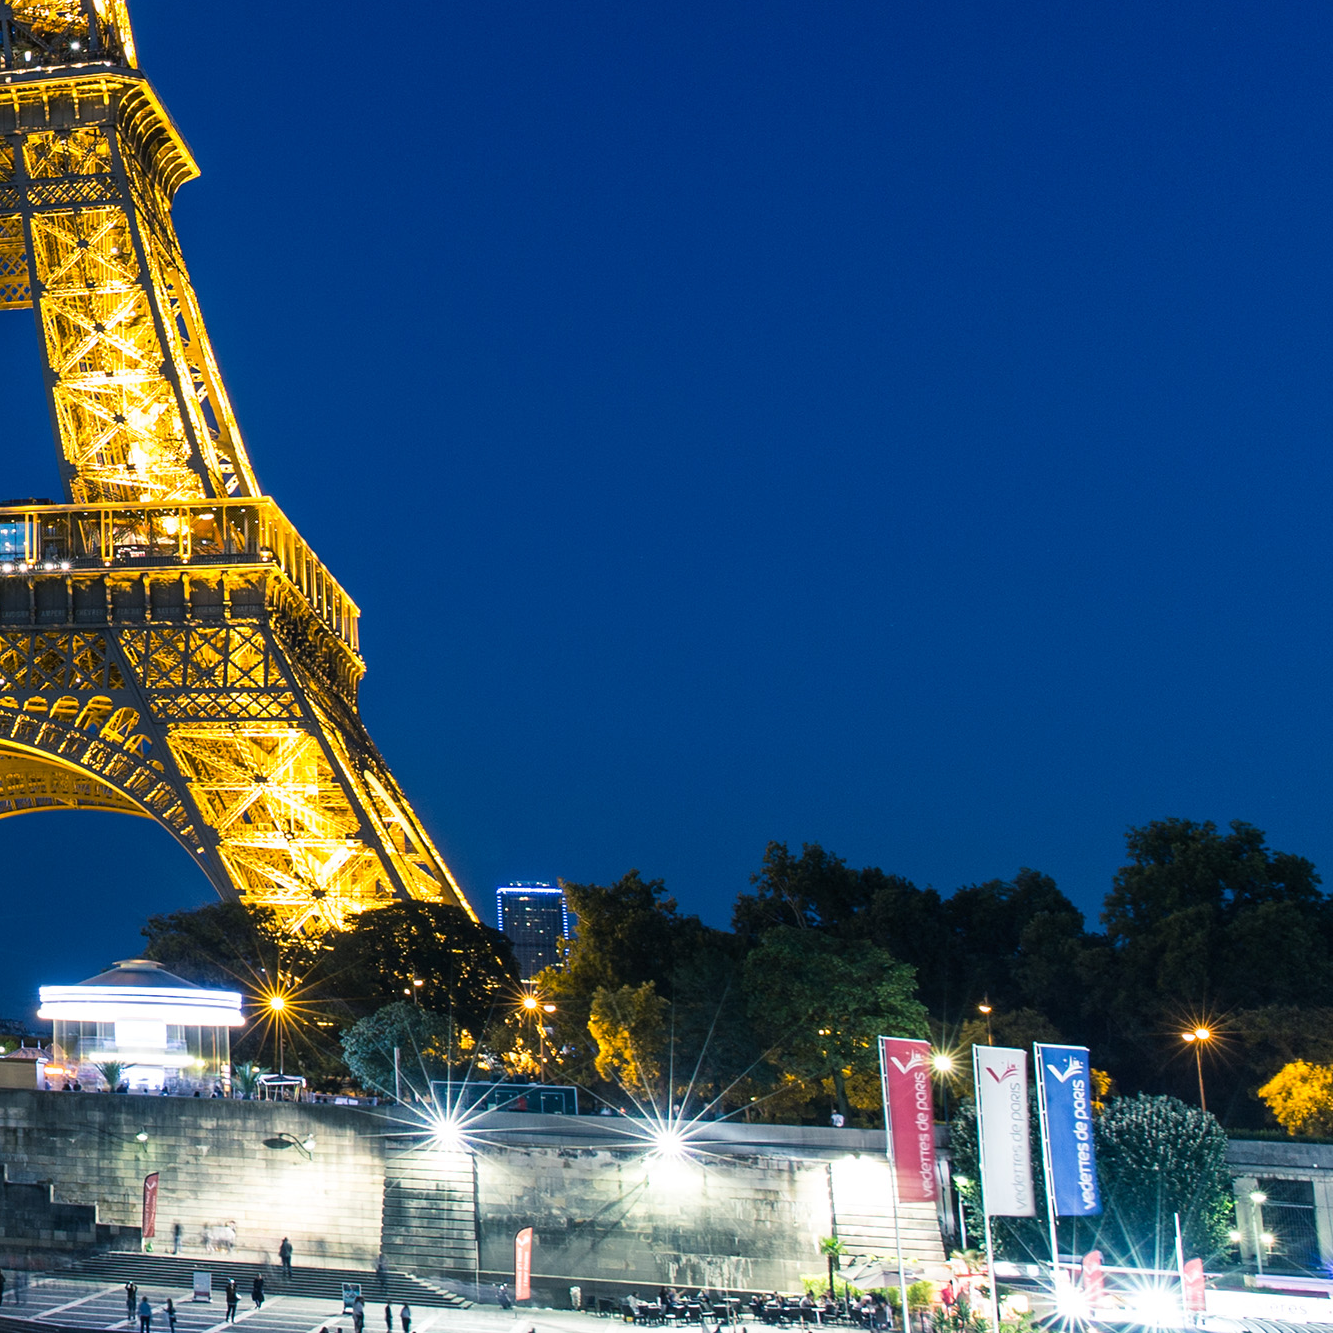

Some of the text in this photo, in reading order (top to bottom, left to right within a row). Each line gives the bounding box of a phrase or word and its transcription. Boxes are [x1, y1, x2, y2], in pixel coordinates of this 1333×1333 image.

[915, 1113, 930, 1132] de
[1009, 1126, 1025, 1144] de
[1073, 1123, 1089, 1141] de
